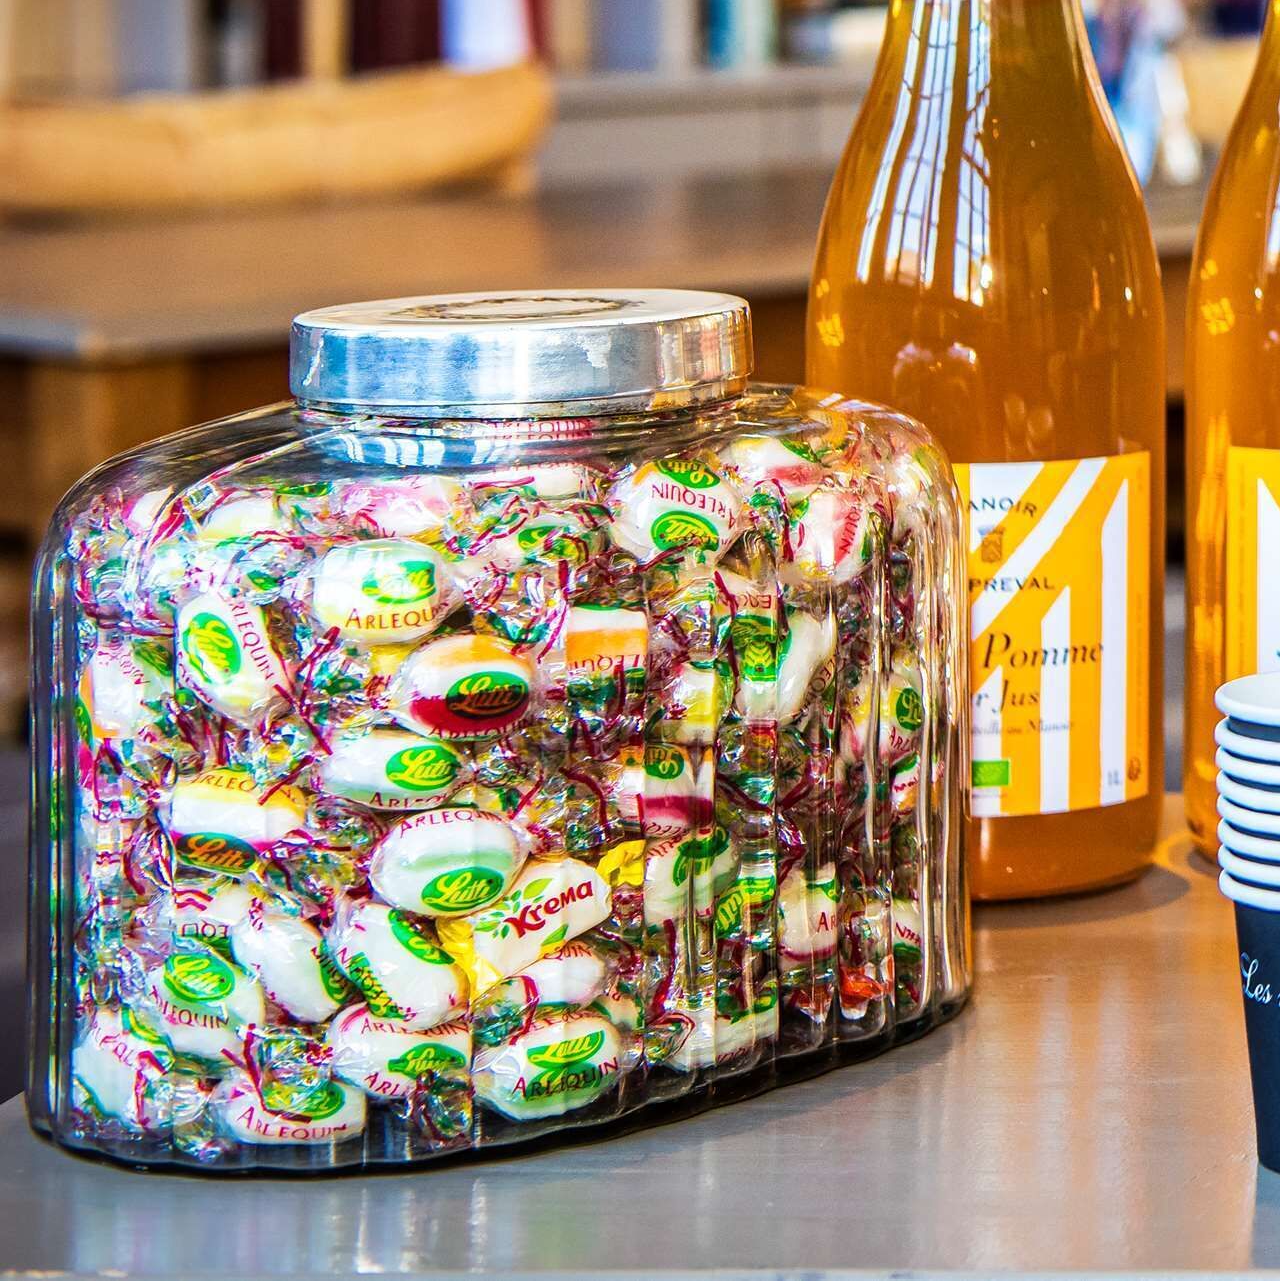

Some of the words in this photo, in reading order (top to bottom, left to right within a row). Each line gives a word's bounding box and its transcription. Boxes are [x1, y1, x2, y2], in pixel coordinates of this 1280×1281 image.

[967, 496, 1037, 518] ANOIR
[968, 576, 1055, 592] PREVAL
[983, 632, 1104, 668] Pomme
[991, 679, 1040, 713] Jus
[422, 872, 493, 908] Lutti
[1241, 952, 1272, 1004] Les
